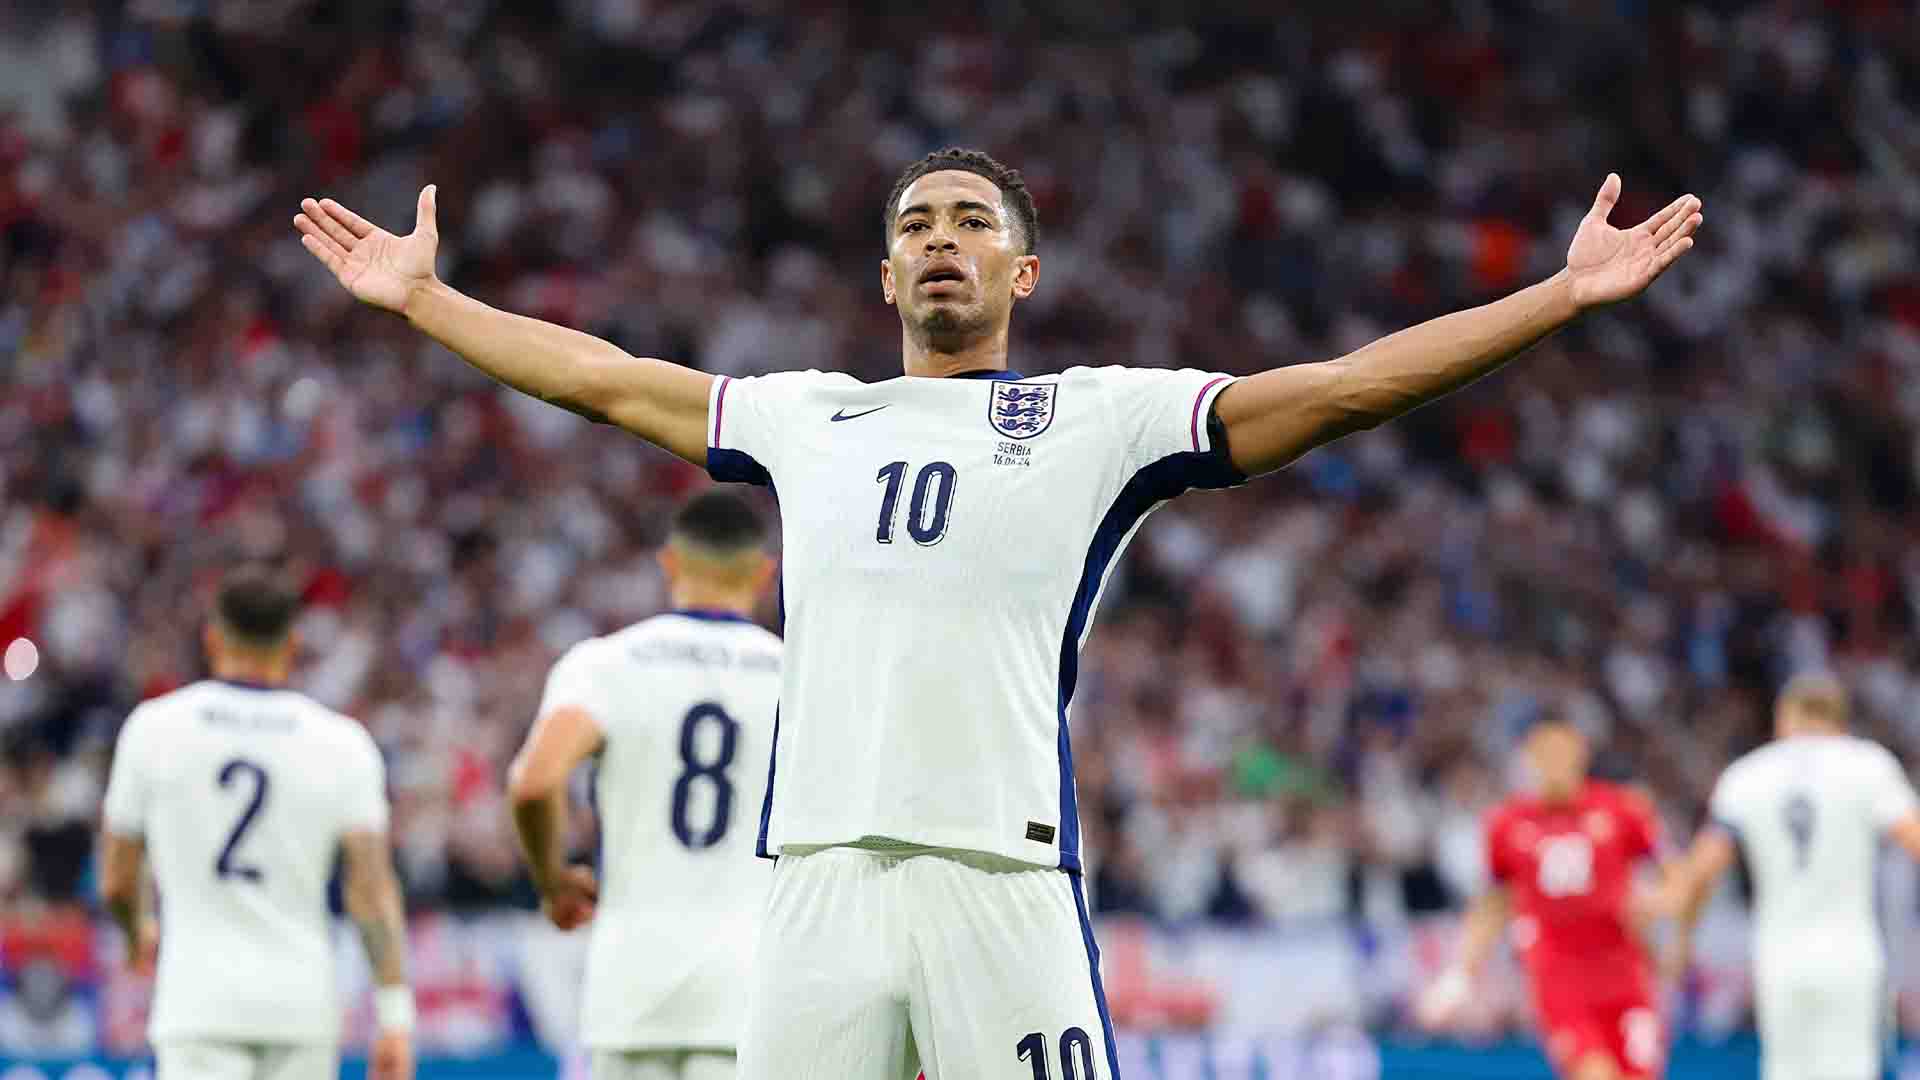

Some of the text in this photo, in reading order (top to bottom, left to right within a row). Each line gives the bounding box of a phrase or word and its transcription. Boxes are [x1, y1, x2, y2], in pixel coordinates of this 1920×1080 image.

[997, 441, 1031, 456] SERBIA
[876, 461, 958, 547] 10
[671, 702, 740, 849] 8
[216, 760, 268, 882] 2
[1016, 1027, 1098, 1080] 10
